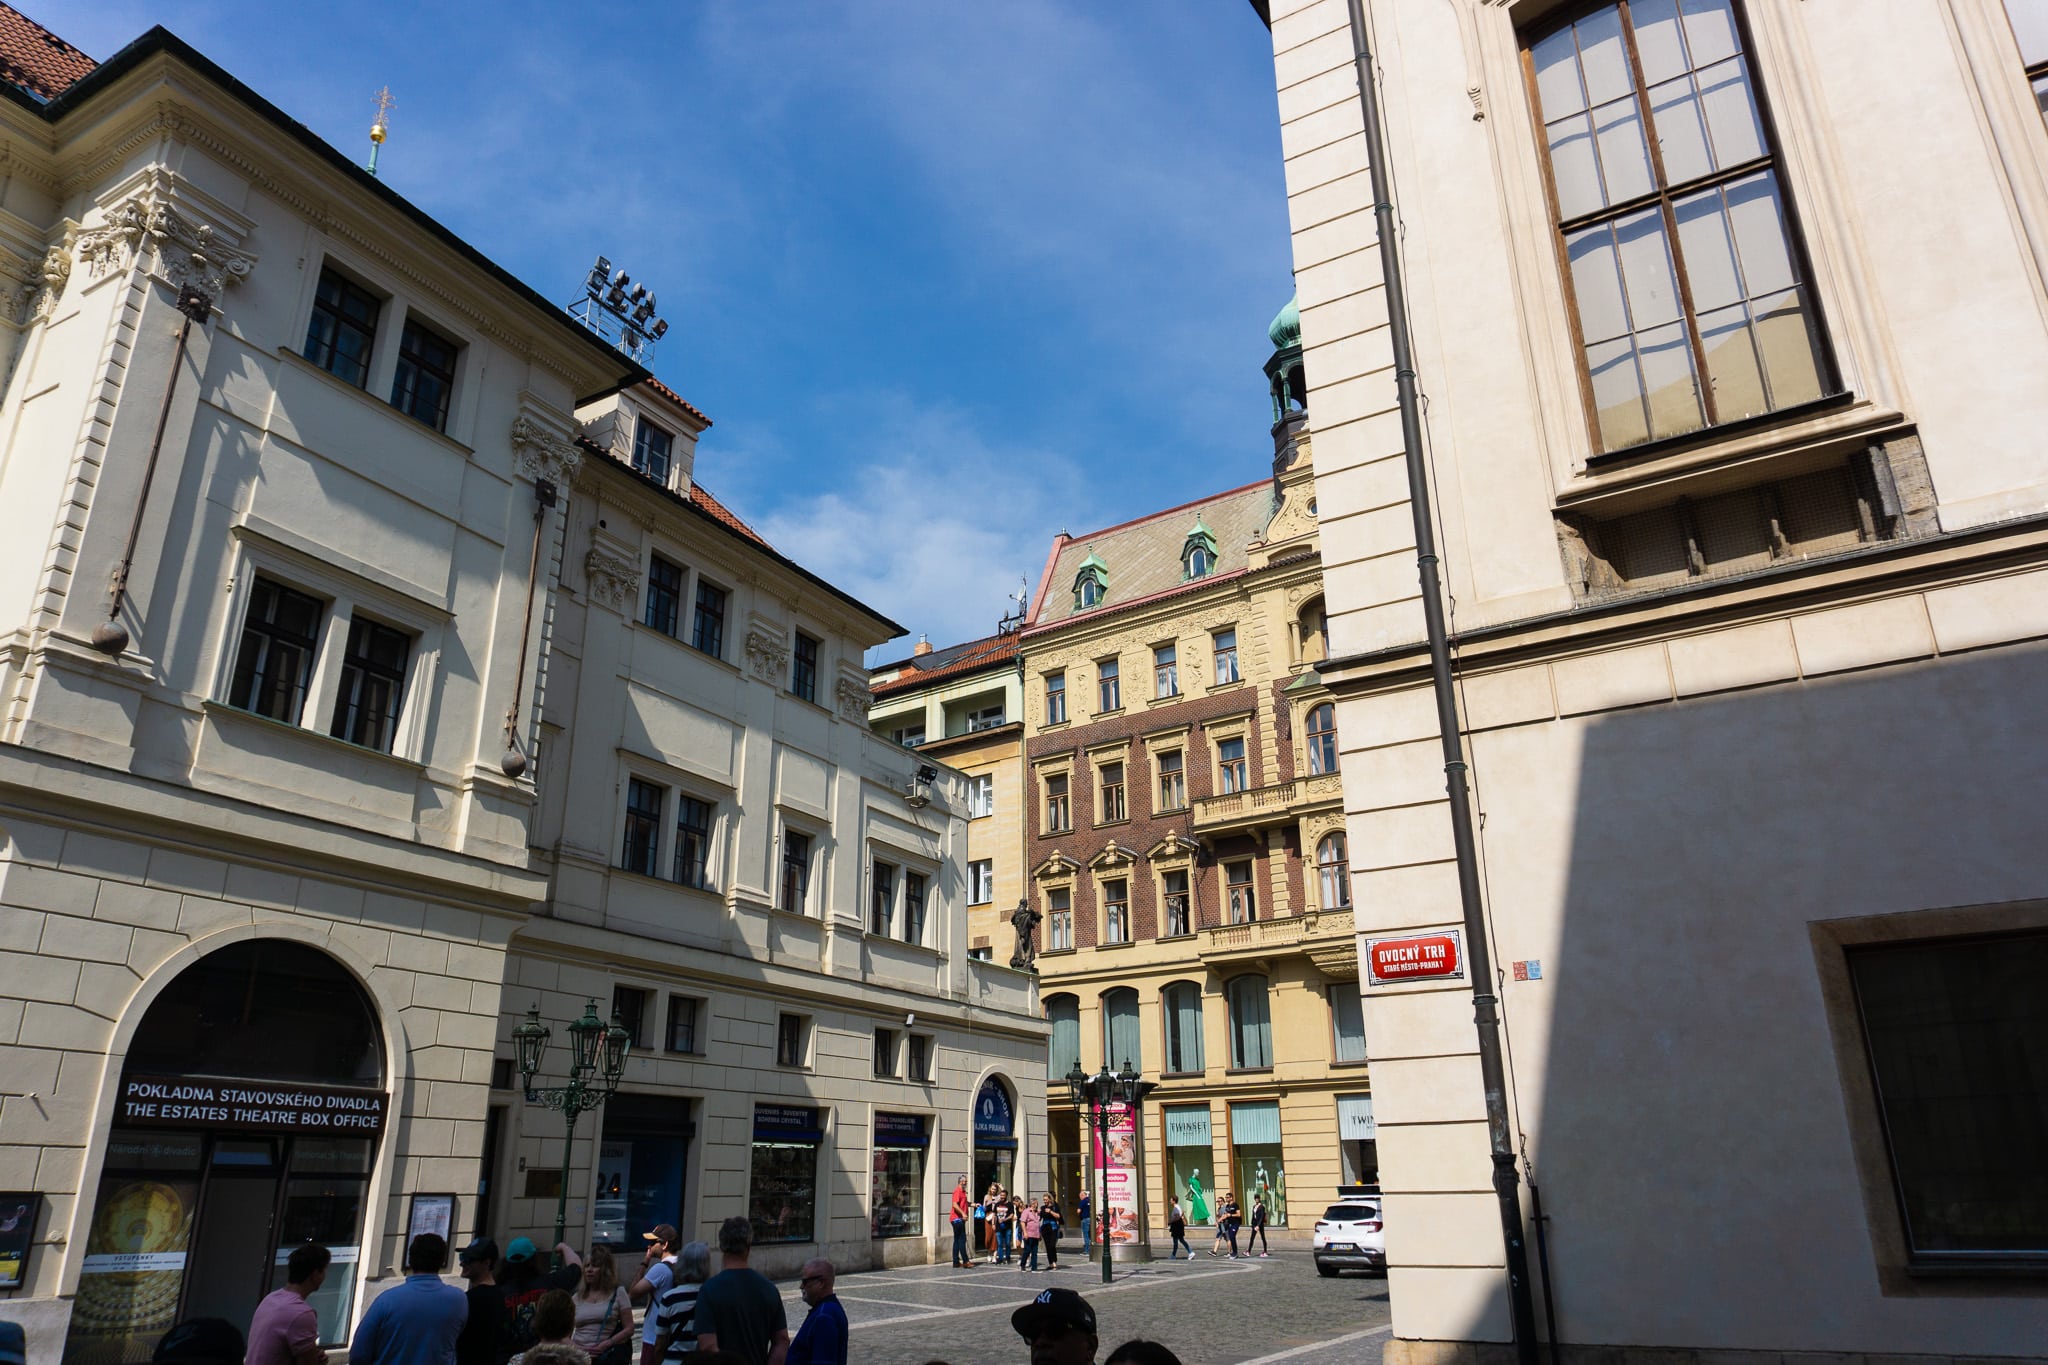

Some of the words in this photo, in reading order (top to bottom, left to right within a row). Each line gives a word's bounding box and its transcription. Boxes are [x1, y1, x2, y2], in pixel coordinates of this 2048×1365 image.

[1379, 944, 1419, 963] OVOCNÝ
[1423, 945, 1446, 959] TRH
[1383, 963, 1401, 973] STARÉ
[127, 1082, 214, 1101] POKLADNA
[219, 1088, 323, 1108] STAVOVSKÉHO
[326, 1096, 381, 1112] DIVADLA
[125, 1102, 156, 1118] THE
[160, 1104, 228, 1121] ESTATES
[233, 1108, 297, 1124] THEATRE
[301, 1112, 330, 1126] BOX
[333, 1114, 380, 1129] OFFICE
[1170, 1121, 1207, 1132] TWINSET
[1037, 1290, 1052, 1304] NY
